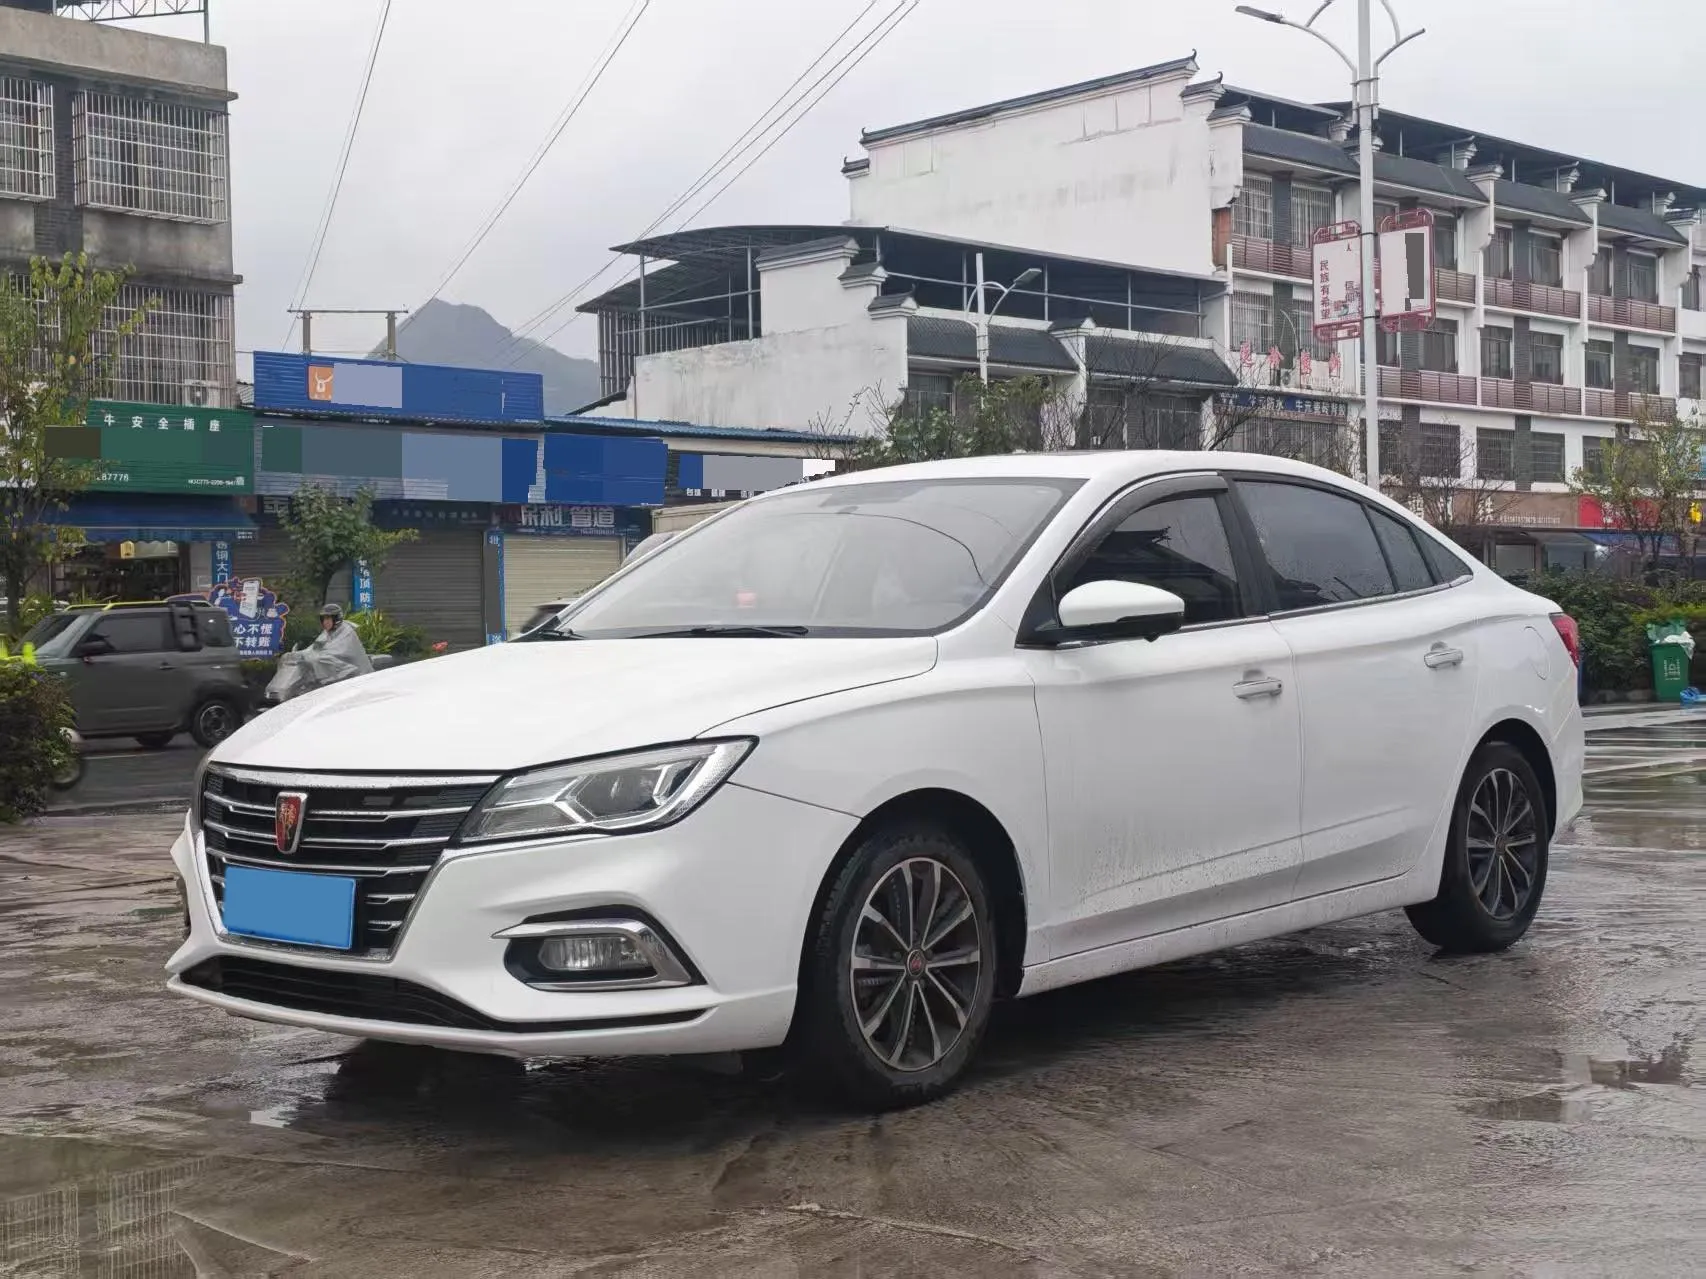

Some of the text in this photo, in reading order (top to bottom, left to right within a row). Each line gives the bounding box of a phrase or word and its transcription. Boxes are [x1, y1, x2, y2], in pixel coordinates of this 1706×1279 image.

[1320, 260, 1330, 319] 民族有希望
[82, 412, 221, 432] 牛安全插座
[233, 622, 273, 634] 心不慌
